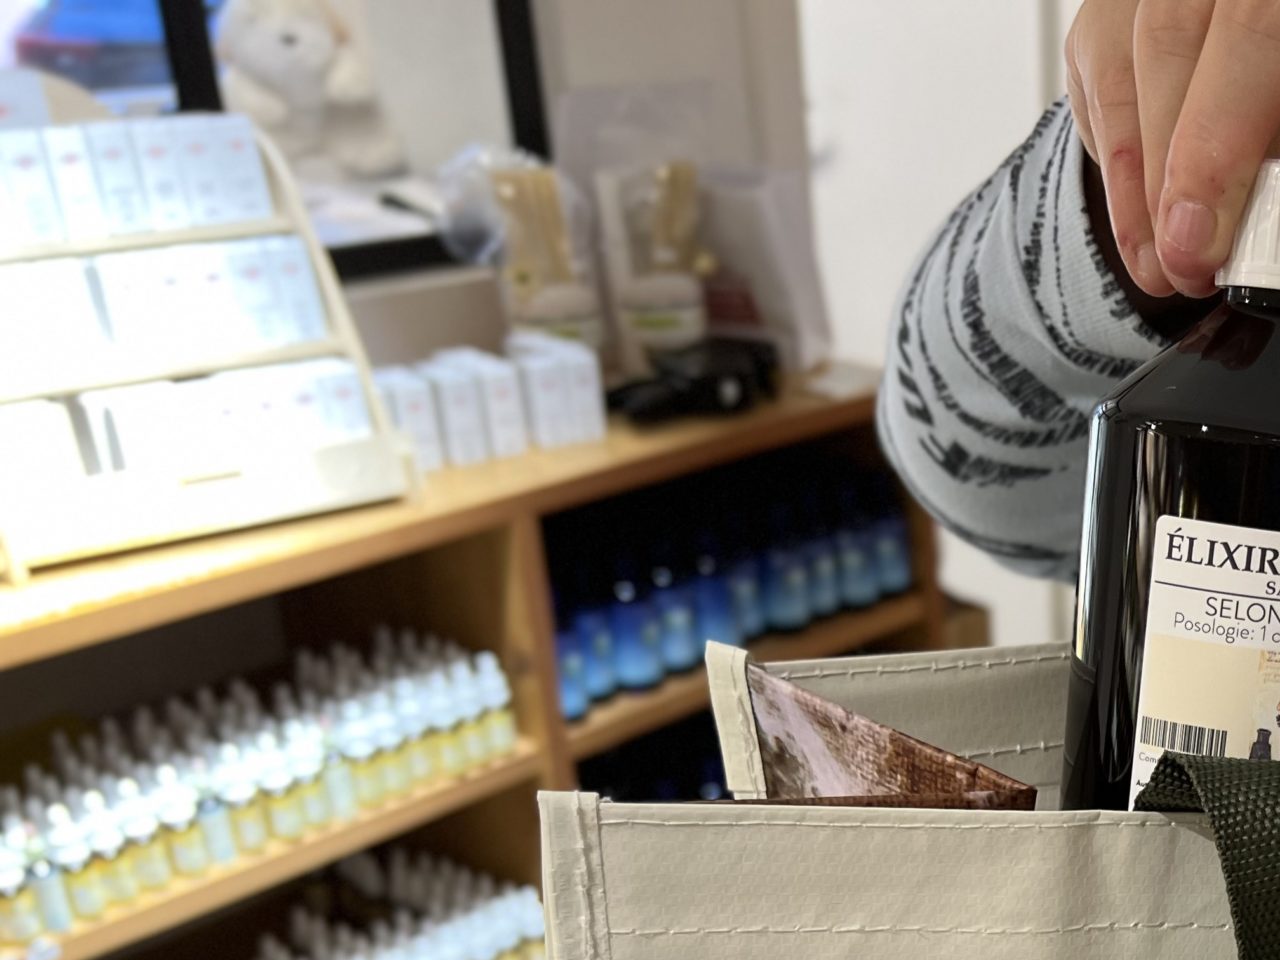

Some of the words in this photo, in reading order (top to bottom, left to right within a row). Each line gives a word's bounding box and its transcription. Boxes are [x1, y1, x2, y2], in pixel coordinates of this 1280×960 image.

[1165, 527, 1280, 576] ÉLIXIR
[1174, 611, 1255, 644] Posologie:
[1260, 625, 1267, 642] 1
[1138, 751, 1157, 764] Com
